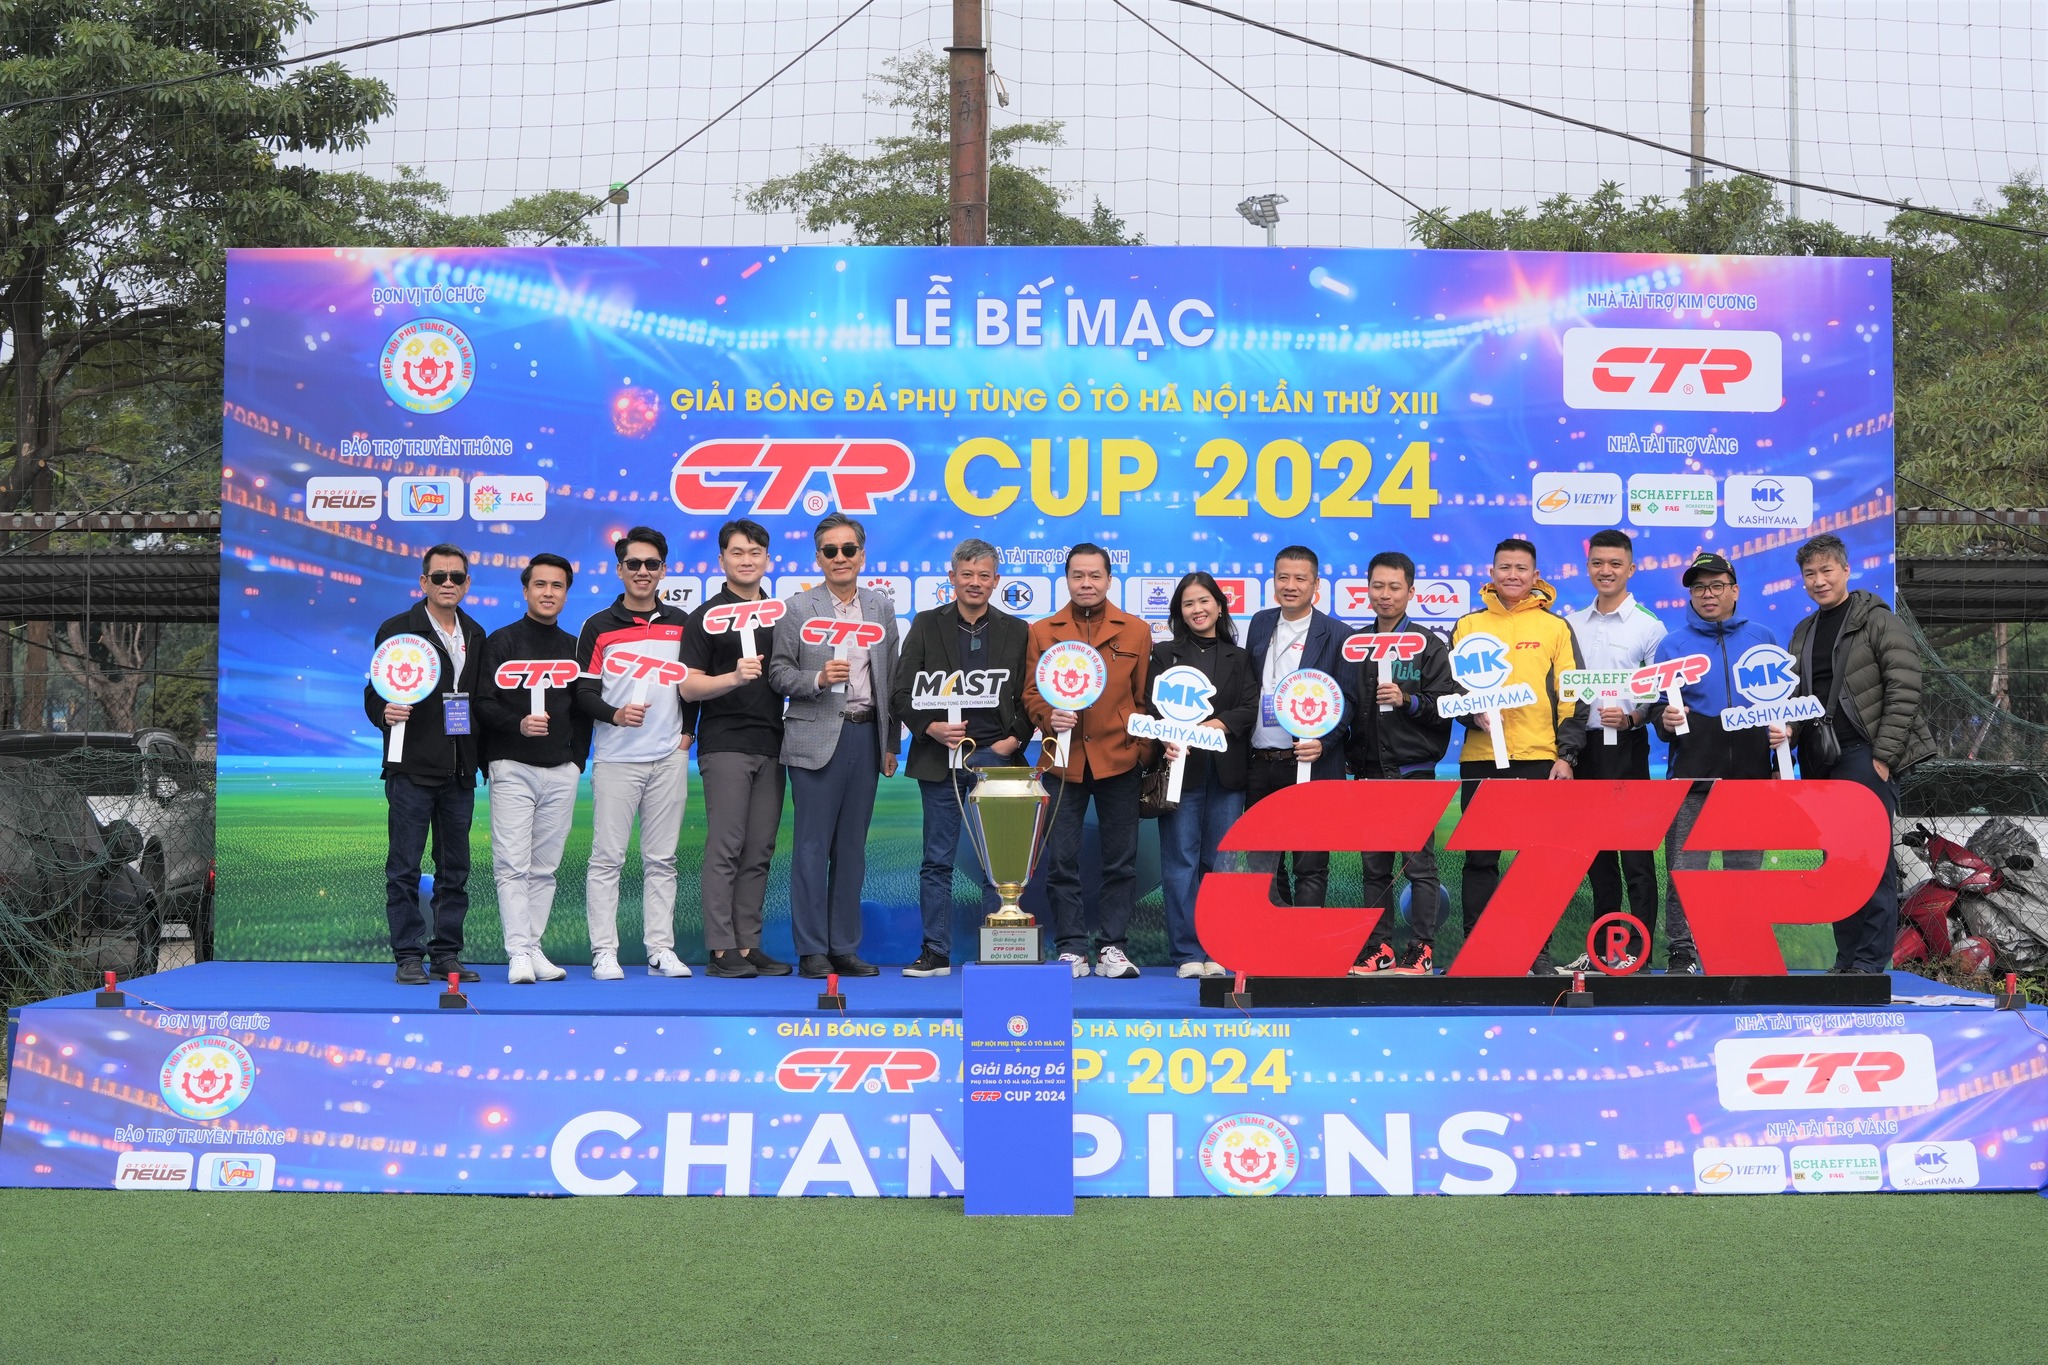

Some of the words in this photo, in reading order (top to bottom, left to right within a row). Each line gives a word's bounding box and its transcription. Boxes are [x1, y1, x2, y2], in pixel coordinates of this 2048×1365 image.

[372, 288, 404, 304] ĐƠN
[406, 288, 420, 306] VỊ
[424, 284, 443, 303] TỔ
[446, 284, 486, 304] CHỨC
[1587, 290, 1618, 308] NHÀ
[1620, 290, 1643, 308] TÀI
[1646, 293, 1675, 311] TRỢ
[1678, 294, 1703, 309] KIM
[1707, 294, 1757, 311] CƯƠNG
[896, 274, 952, 346] LỄ
[976, 276, 1055, 346] BẾ
[1067, 298, 1215, 361] MẠC
[671, 380, 734, 411] GIẢI
[746, 381, 834, 412] BÓNG
[844, 381, 887, 412] ĐÁ
[898, 389, 956, 418] PHỤ
[967, 382, 1048, 412] TÙNG
[1057, 382, 1081, 412] Ô
[1090, 382, 1129, 412] TÔ
[1140, 383, 1182, 412] HÀ
[1193, 383, 1246, 419] NỘI
[1258, 378, 1313, 413] LẦN
[1323, 384, 1380, 414] THỨ
[1389, 391, 1438, 414] XIII
[341, 435, 371, 457] BẢO
[372, 438, 403, 459] TRỢ
[405, 435, 460, 456] TRUYỀN
[462, 436, 513, 456] THÔNG
[1608, 433, 1640, 452] NHÀ
[1641, 433, 1665, 453] TÀI
[1666, 436, 1697, 457] TRỢ
[1698, 434, 1738, 455] VÀNG
[944, 437, 1158, 517] CUP
[1194, 438, 1438, 518] 2024
[510, 492, 534, 502] FAG
[1573, 493, 1618, 505] VIETMY
[1630, 490, 1714, 501] SCHAEFFLER
[1751, 487, 1785, 502] MK
[1738, 515, 1798, 525] KASHIYAMA
[1006, 547, 1026, 564] TÀI
[1028, 549, 1054, 566] TRỢ
[1103, 547, 1130, 565] ÀNH
[1416, 594, 1460, 603] VMA
[1391, 661, 1422, 680] Nike
[1454, 648, 1508, 676] MK
[915, 672, 1007, 696] MAST
[1563, 673, 1632, 685] SCHAEFF
[1738, 660, 1794, 689] MK
[1157, 681, 1211, 710] MK
[1442, 689, 1533, 714] KASHIYAMA
[1726, 702, 1821, 727] KASHIYAMA
[1132, 720, 1223, 748] KASHIYAMA
[159, 1014, 189, 1028] ĐƠN
[192, 1015, 207, 1030] VỊ
[208, 1011, 229, 1029] TỔ
[230, 1012, 270, 1030] CHỨC
[777, 1018, 820, 1036] GIẢI
[827, 1019, 887, 1037] BÓNG
[893, 1020, 922, 1037] ĐÁ
[1090, 1020, 1119, 1038] HÀ
[1125, 1020, 1162, 1041] NỘI
[1213, 1020, 1252, 1038] THỨ
[1258, 1023, 1291, 1038] XIII
[1735, 1014, 1768, 1031] NHÀ
[1769, 1013, 1792, 1030] TÀI
[1793, 1014, 1824, 1031] TRỢ
[1826, 1014, 1851, 1029] KIM
[1854, 1012, 1905, 1028] CƯƠNG
[970, 1062, 1001, 1075] Giải
[1004, 1062, 1041, 1078] Bóng
[1045, 1062, 1065, 1075] Đá
[1127, 1047, 1292, 1094] 2024
[1004, 1091, 1031, 1101] CUP
[1035, 1091, 1066, 1101] 2024
[114, 1124, 144, 1143] BẢO
[146, 1127, 177, 1146] TRỢ
[178, 1126, 234, 1144] TRUYỀN
[235, 1128, 285, 1145] THÔNG
[1767, 1119, 1799, 1137] NHÀ
[1801, 1119, 1824, 1136] TÀI
[1827, 1121, 1855, 1138] TRỢ
[1858, 1117, 1898, 1135] VÀNG
[1793, 1158, 1877, 1169] SCHAEFFLER
[1914, 1152, 1948, 1165] MK
[1736, 1164, 1780, 1176] VIETMY
[1904, 1175, 1965, 1186] KASHIYAMA
